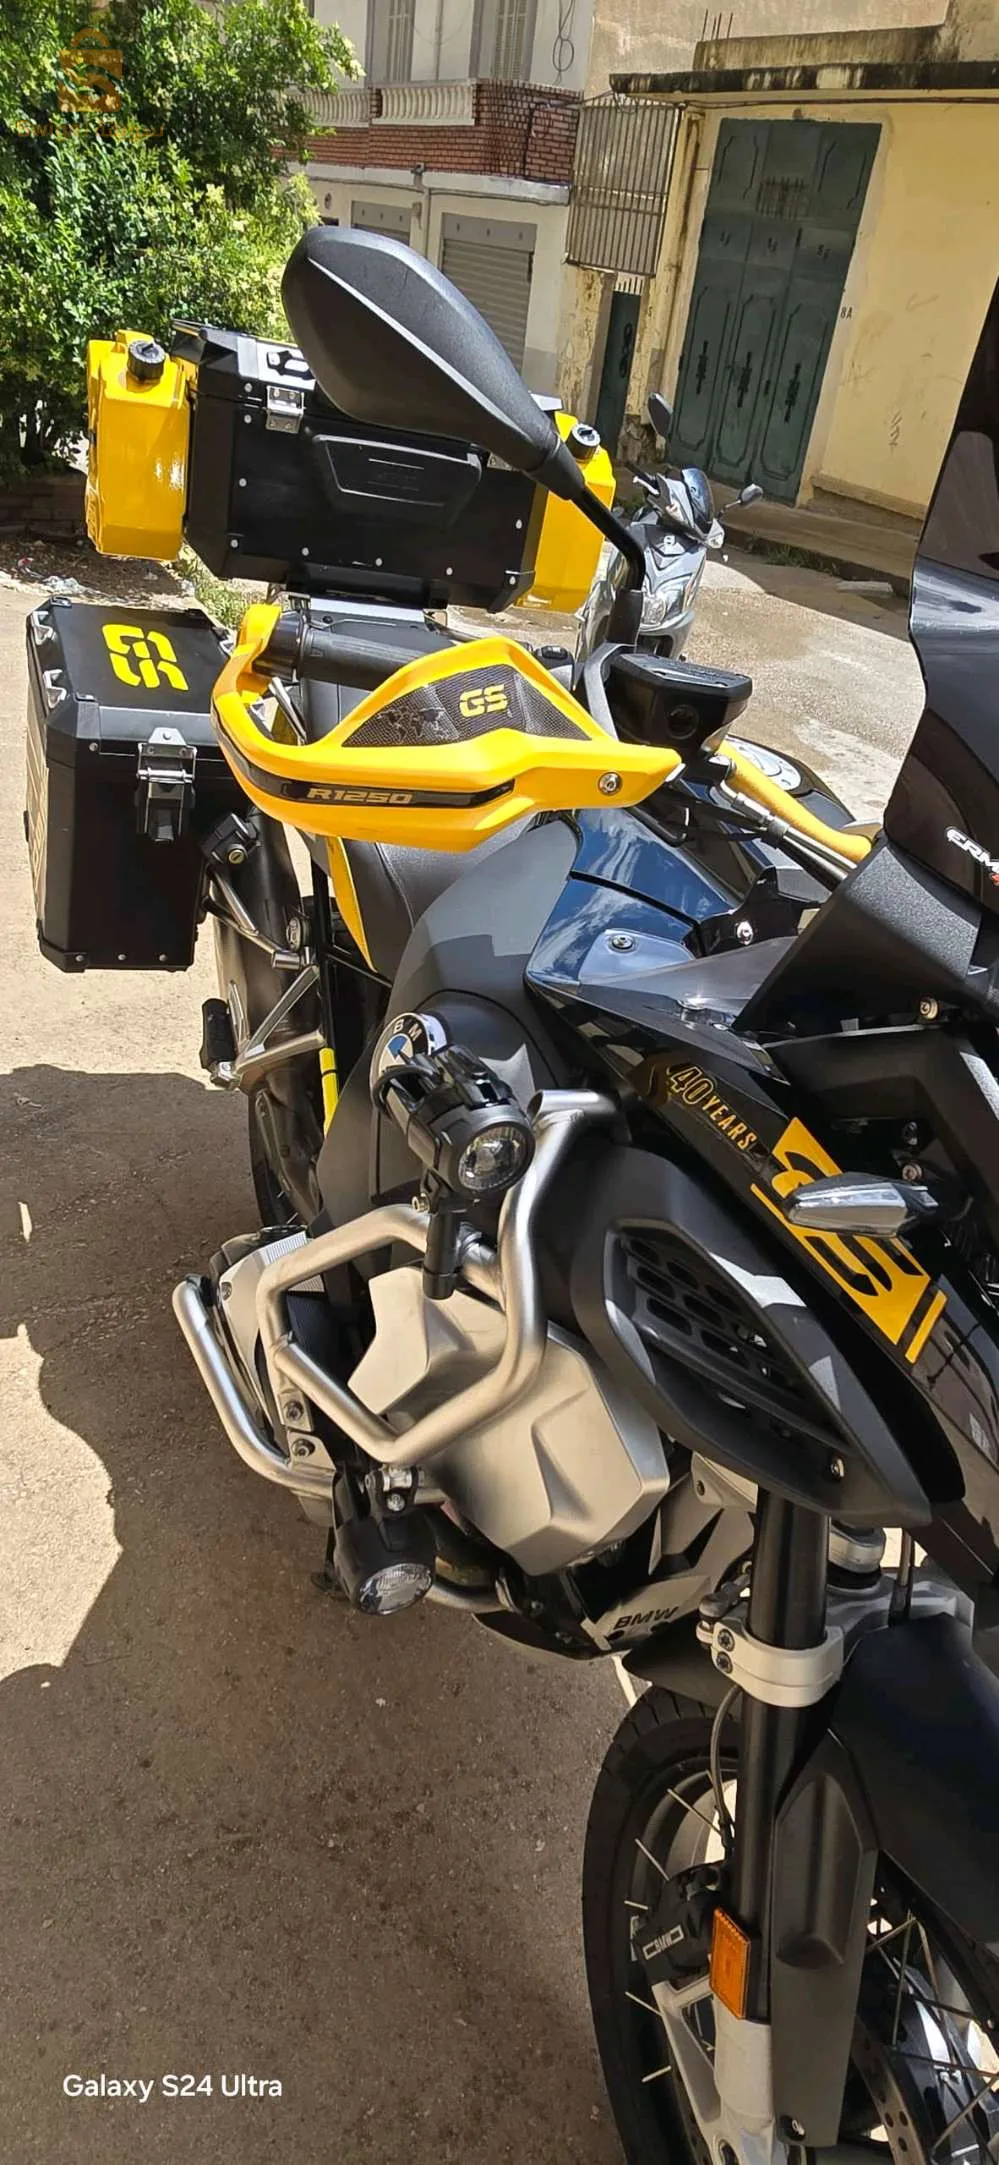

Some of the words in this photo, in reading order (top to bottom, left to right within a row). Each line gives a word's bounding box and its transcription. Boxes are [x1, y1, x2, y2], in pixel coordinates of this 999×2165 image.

[841, 306, 853, 319] 8A
[460, 684, 508, 717] GS
[307, 787, 413, 804] R1250
[946, 828, 999, 874] ERM
[393, 1018, 423, 1042] BM
[670, 1066, 714, 1104] 40
[702, 1096, 757, 1150] YEARS
[613, 1606, 679, 1630] BMW
